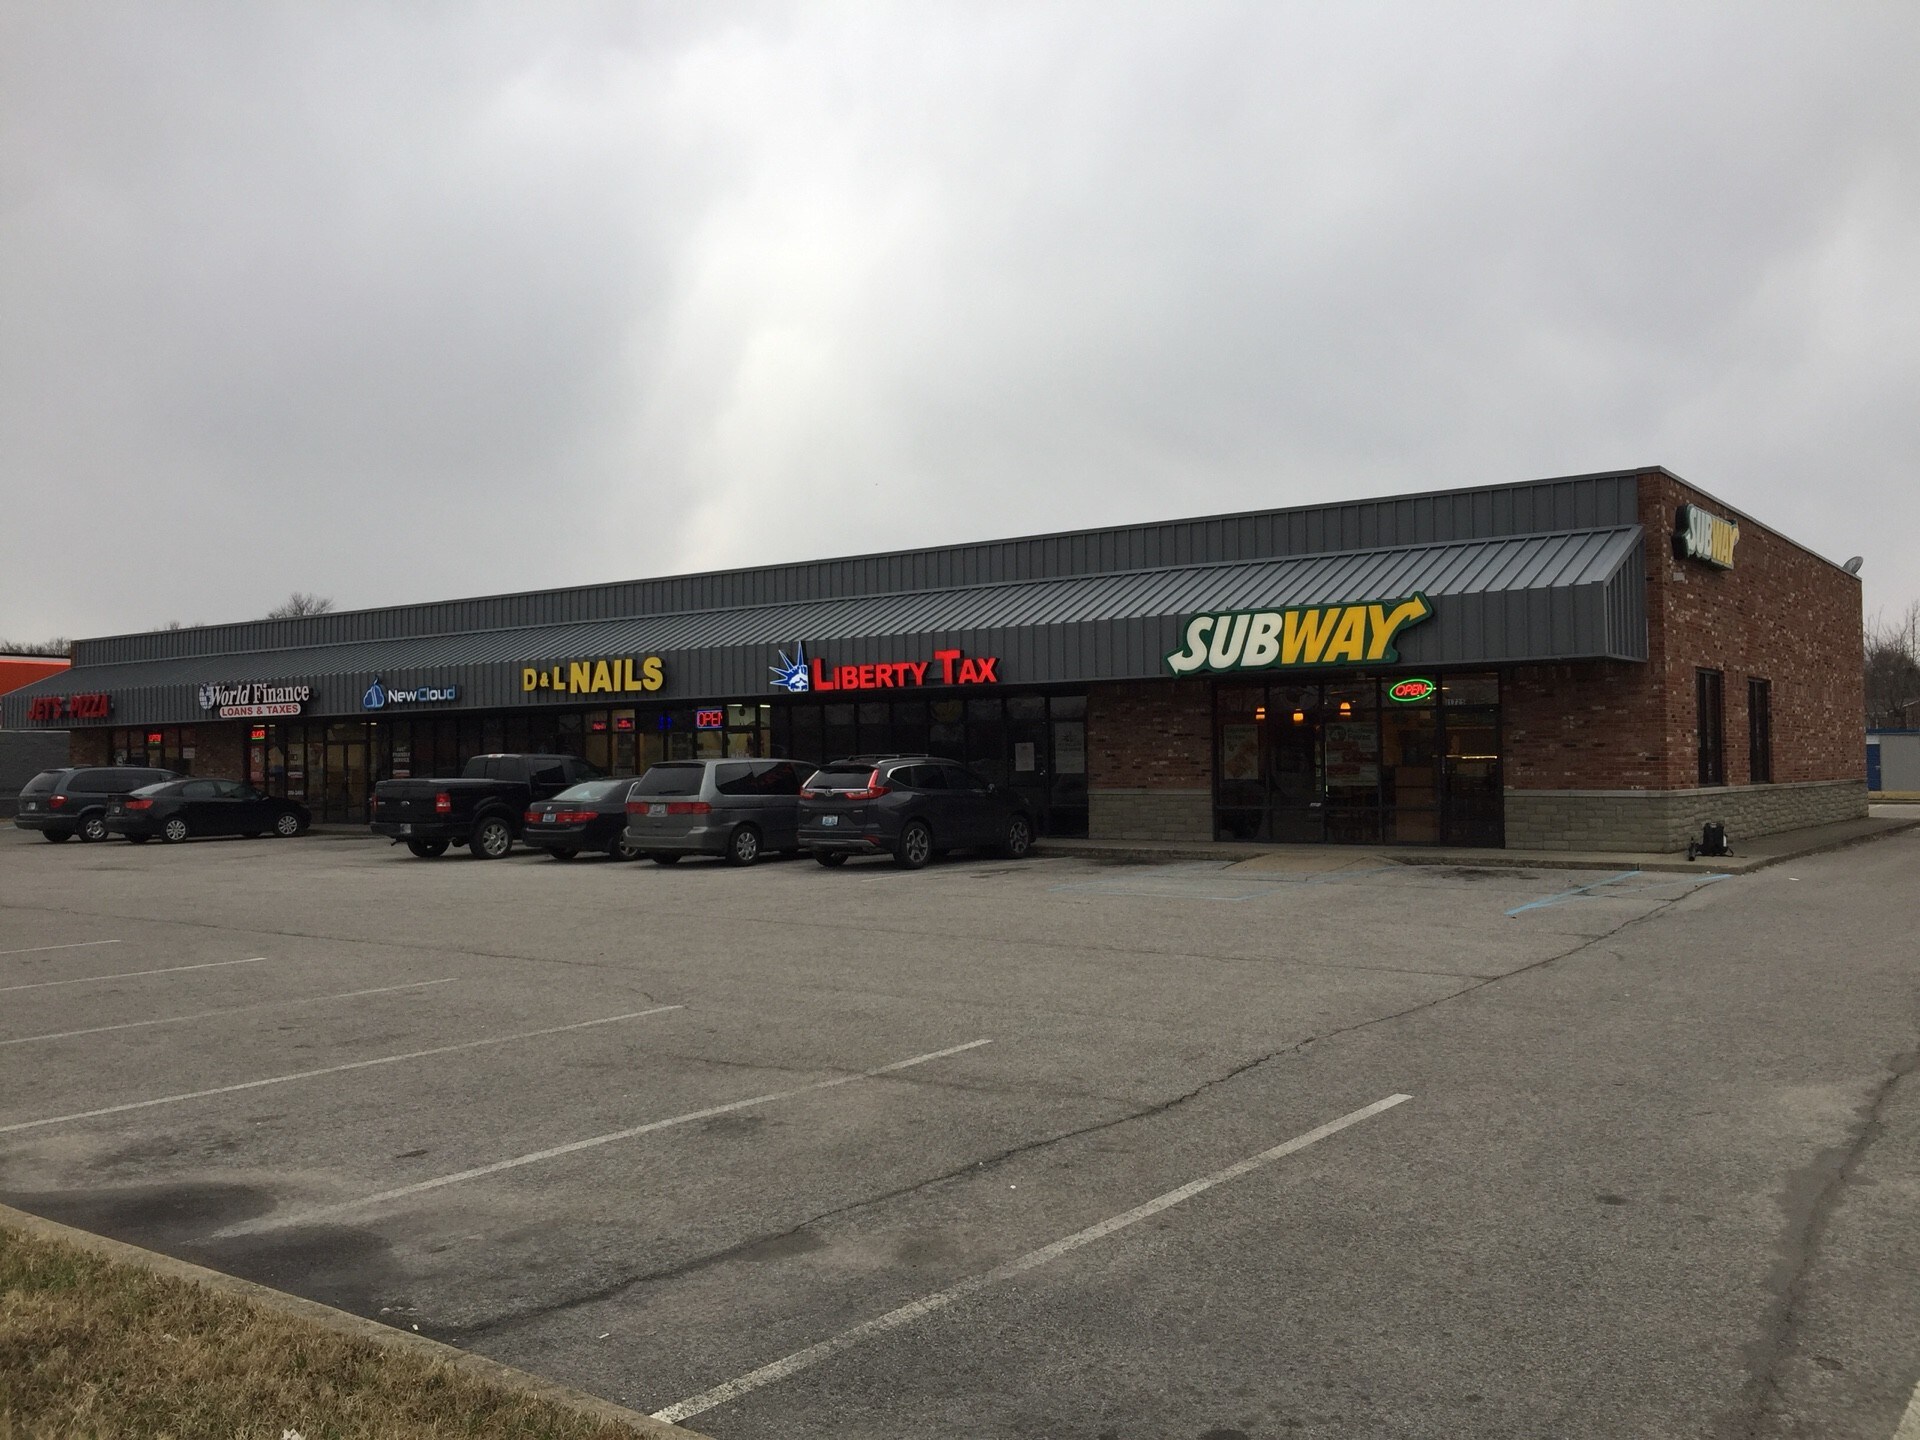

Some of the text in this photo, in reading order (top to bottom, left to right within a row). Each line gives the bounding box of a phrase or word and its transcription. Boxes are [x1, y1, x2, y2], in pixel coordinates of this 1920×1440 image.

[1685, 507, 1739, 565] SUBWAY
[1167, 595, 1428, 675] SUBWAY
[570, 656, 664, 694] NAILS
[813, 649, 999, 691] LIBERTY TAX
[210, 683, 310, 706] World Finance
[387, 684, 457, 704] NewCloud
[1395, 683, 1428, 697] OPEN
[27, 693, 110, 721] JET'S PIZZA
[222, 703, 299, 717] LOANS & TAXES
